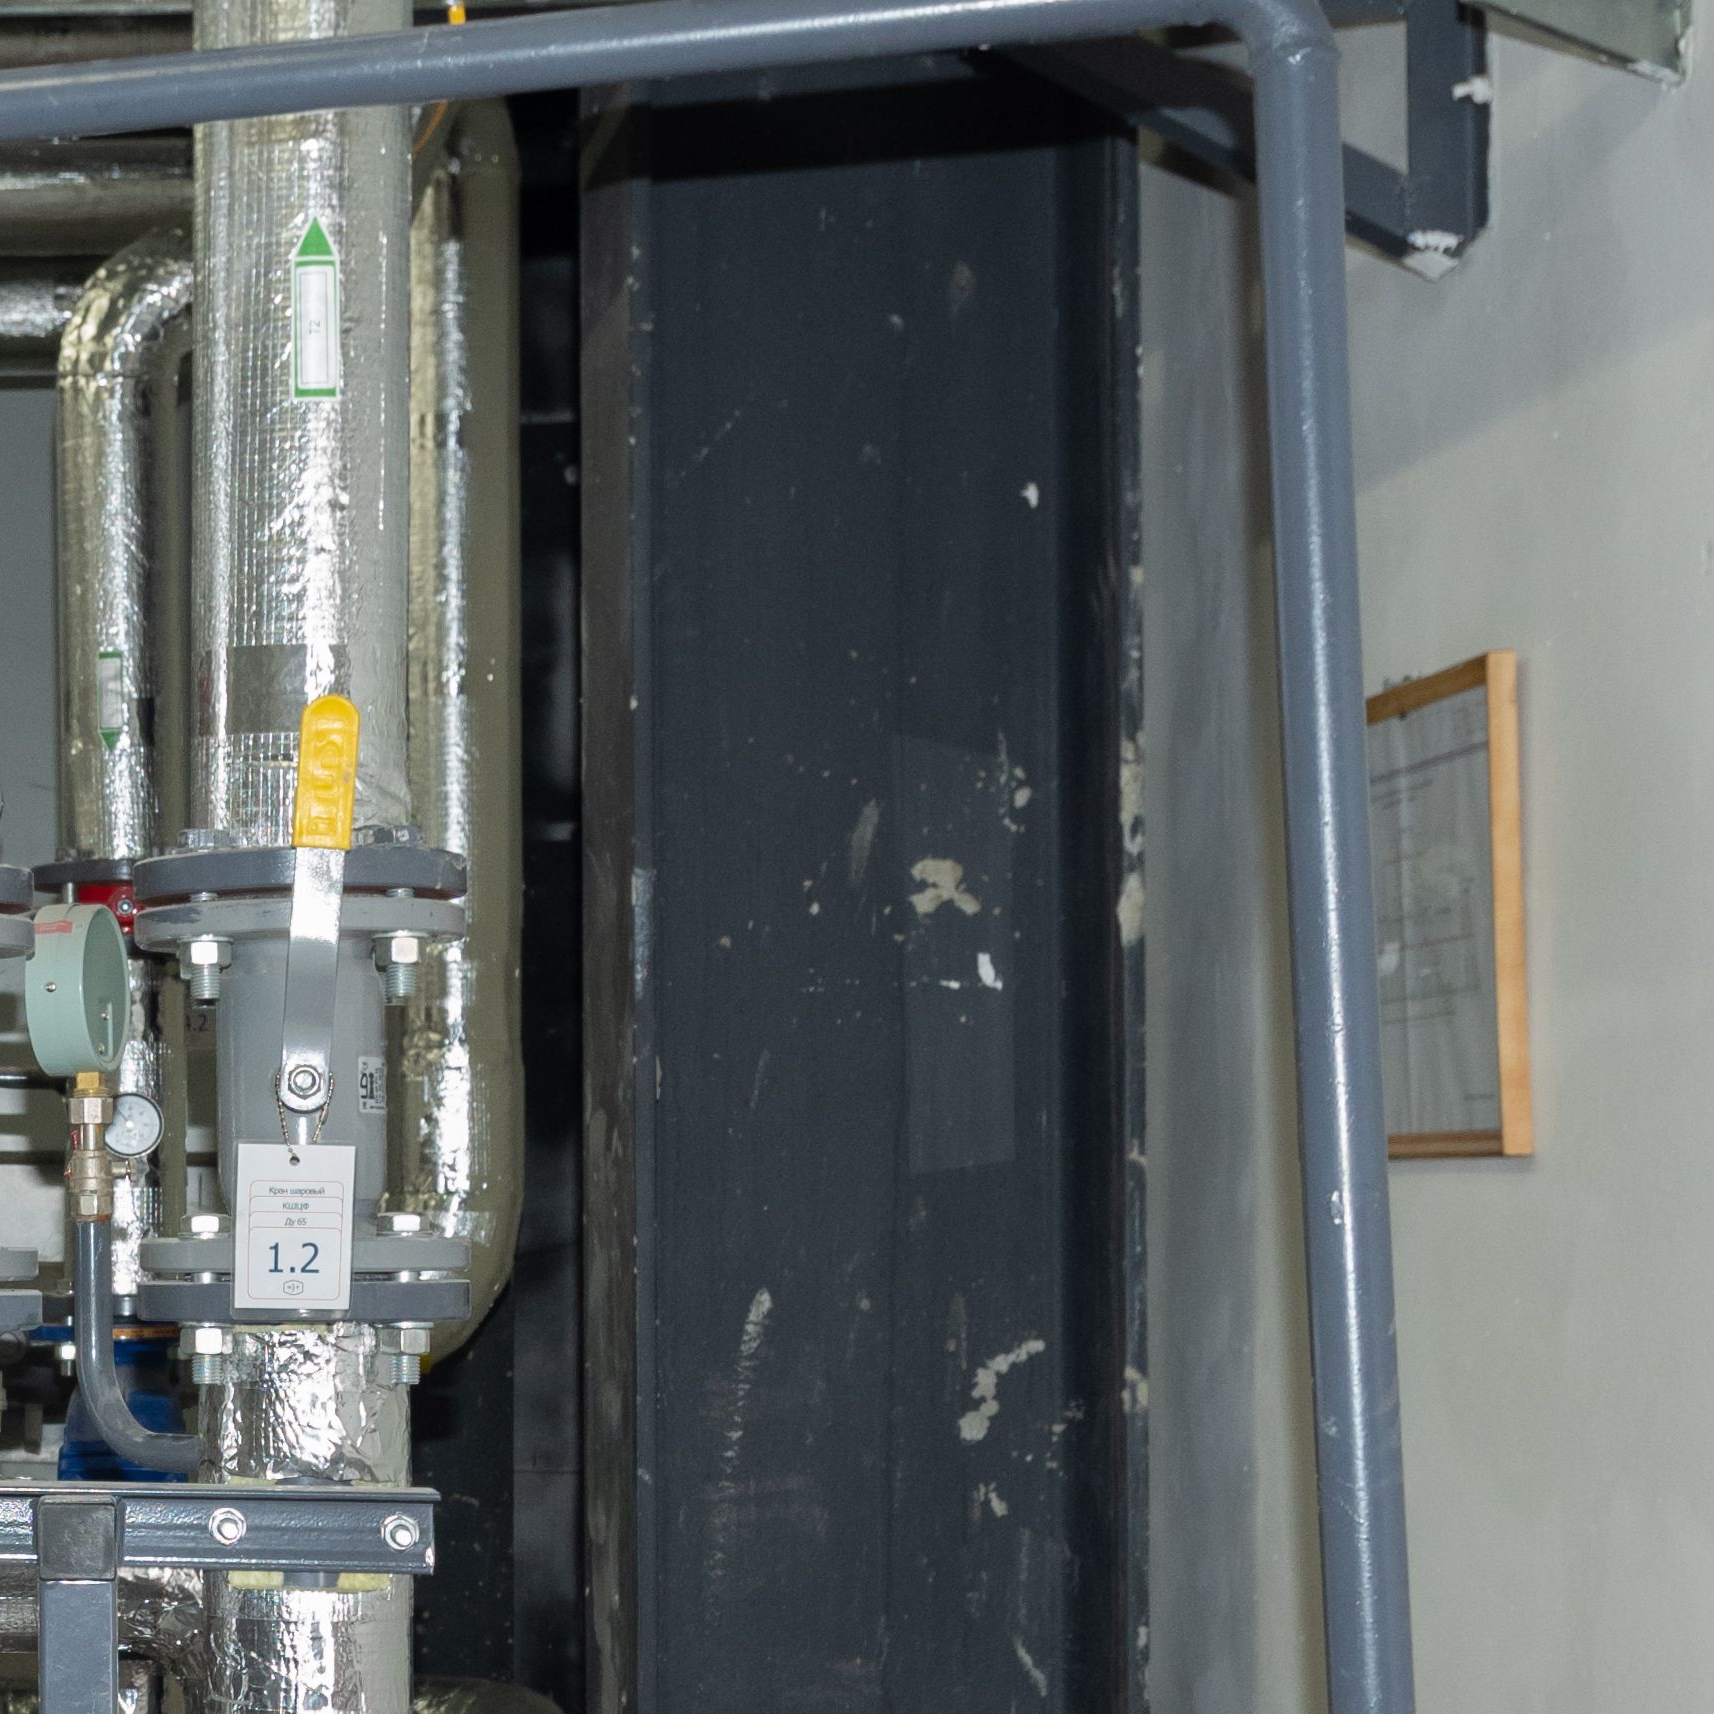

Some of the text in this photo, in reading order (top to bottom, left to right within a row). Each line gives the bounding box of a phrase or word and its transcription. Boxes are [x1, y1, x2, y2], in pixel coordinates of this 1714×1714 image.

[268, 1186, 325, 1196] Кран шаровый
[284, 1217, 307, 1226] Ду 65
[268, 1242, 319, 1274] 1.2
